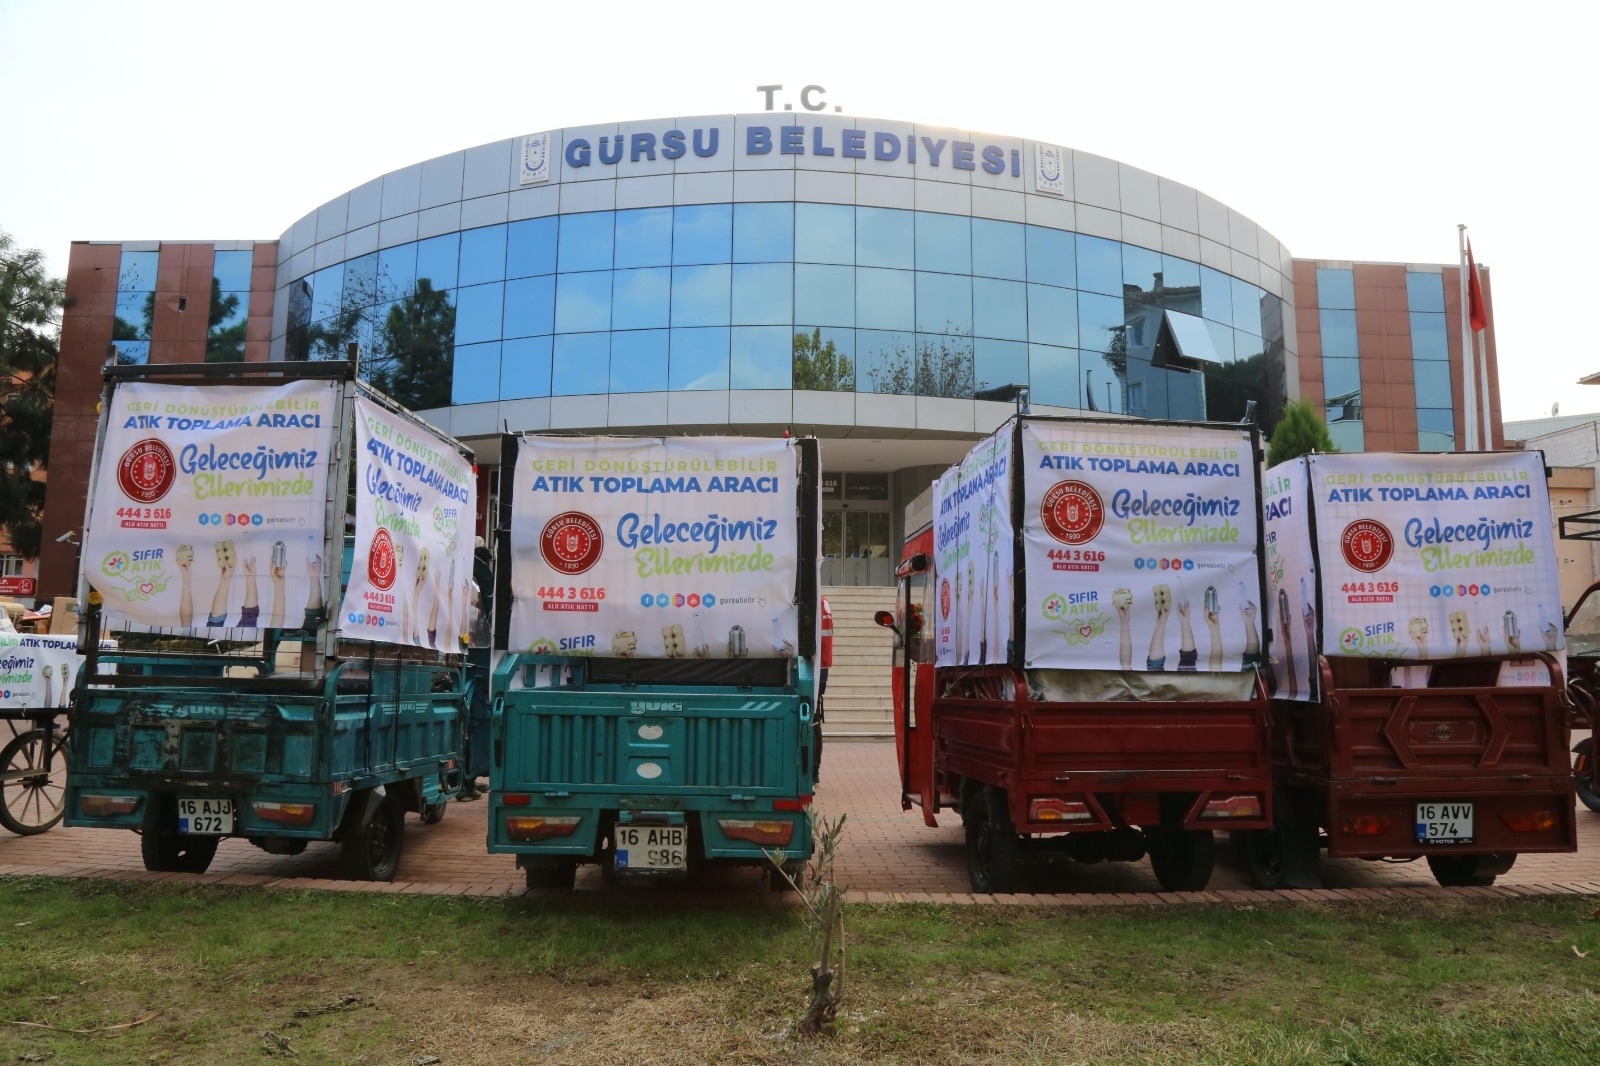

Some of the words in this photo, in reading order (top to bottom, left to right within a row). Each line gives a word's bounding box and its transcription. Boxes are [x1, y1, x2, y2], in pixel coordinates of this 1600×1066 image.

[564, 127, 719, 168] GÜRSU
[745, 125, 1020, 178] BELEDİYESİ
[128, 401, 158, 413] GERİ
[123, 414, 164, 429] ATIK
[166, 415, 252, 430] TOPLAMA
[256, 413, 320, 428] ARACI
[1039, 441, 1075, 452] GERİ
[180, 443, 318, 480] Geleceğimiz
[532, 457, 576, 472] GERİ
[584, 456, 777, 475] DÖNÜŞTÜRÜLEBİLİR
[1039, 455, 1084, 470] ATIK
[1088, 457, 1179, 475] TOPLAMA
[1183, 462, 1240, 477] ARACI
[192, 472, 314, 500] Ellerimizde
[532, 476, 584, 493] ATIK
[589, 476, 702, 494] TOPLAMA
[707, 477, 778, 494] ARACI
[1325, 473, 1364, 485] GERİ
[442, 479, 469, 505] ARACI
[1328, 488, 1374, 502] ATIK
[1378, 487, 1469, 501] TOPLAMA
[1473, 485, 1531, 500] ARACI
[116, 507, 142, 518] 444
[144, 508, 150, 518] 3
[153, 509, 171, 520] 616
[1112, 488, 1240, 526] Geleceğimiz
[546, 519, 565, 540] GÜRSU
[565, 517, 597, 541] BELEDİYESİ
[617, 512, 778, 554] Geleceğimiz
[1127, 518, 1239, 544] Ellerimizde
[1404, 517, 1534, 550] Geleceğimiz
[132, 548, 164, 561] SIFIR
[635, 543, 774, 579] Ellerimizde
[1047, 550, 1071, 561] 444
[1074, 550, 1081, 561] 3
[1083, 550, 1105, 562] 616
[1420, 542, 1534, 573] Ellerimizde
[131, 560, 162, 572] ATIK
[537, 587, 564, 598] 444
[568, 587, 576, 599] 3
[579, 587, 606, 600] 616
[1341, 582, 1367, 592] 444
[1368, 582, 1375, 592] 3
[1377, 582, 1398, 592] 616
[1069, 591, 1098, 604] SIFIR
[1070, 603, 1099, 616] ATIK
[1365, 622, 1395, 637] SIFIR
[20, 639, 40, 648] ATIK
[560, 635, 595, 650] SIFIR
[1367, 635, 1395, 648] ATIK
[180, 801, 196, 814] 16
[203, 801, 231, 814] AJJ
[1420, 806, 1435, 819] 16
[1440, 806, 1471, 819] AVV
[194, 817, 222, 832] 672
[1429, 823, 1458, 836] 574
[620, 829, 639, 846] 16
[647, 830, 682, 846] AHB
